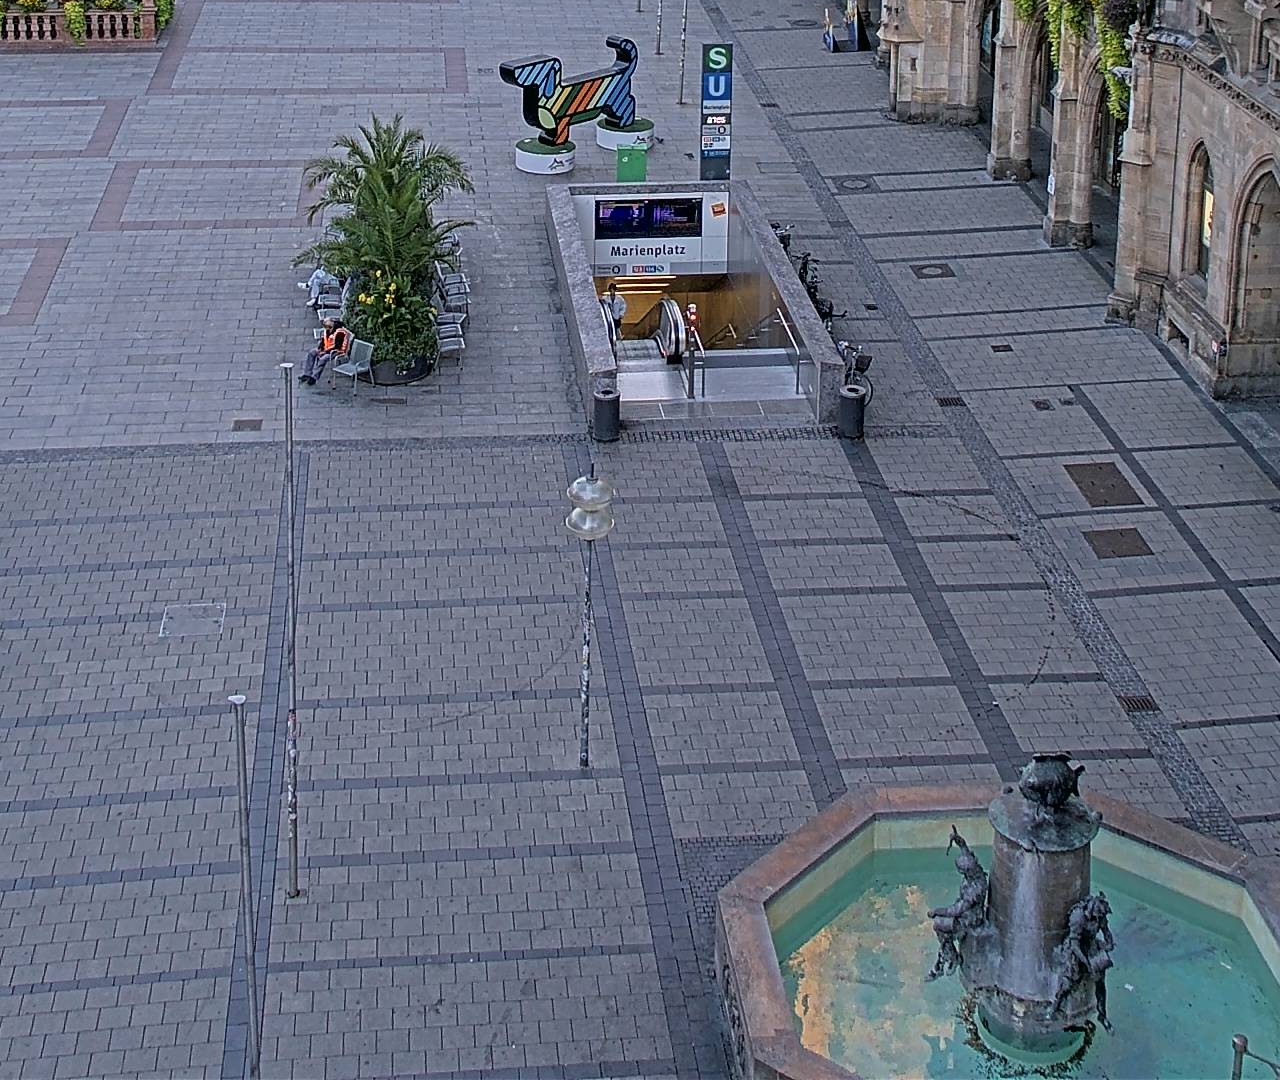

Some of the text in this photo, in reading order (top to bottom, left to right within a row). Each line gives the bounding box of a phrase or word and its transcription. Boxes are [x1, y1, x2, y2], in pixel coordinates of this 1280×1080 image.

[708, 47, 727, 69] S
[708, 75, 726, 97] U
[610, 243, 686, 258] Marienplatz
